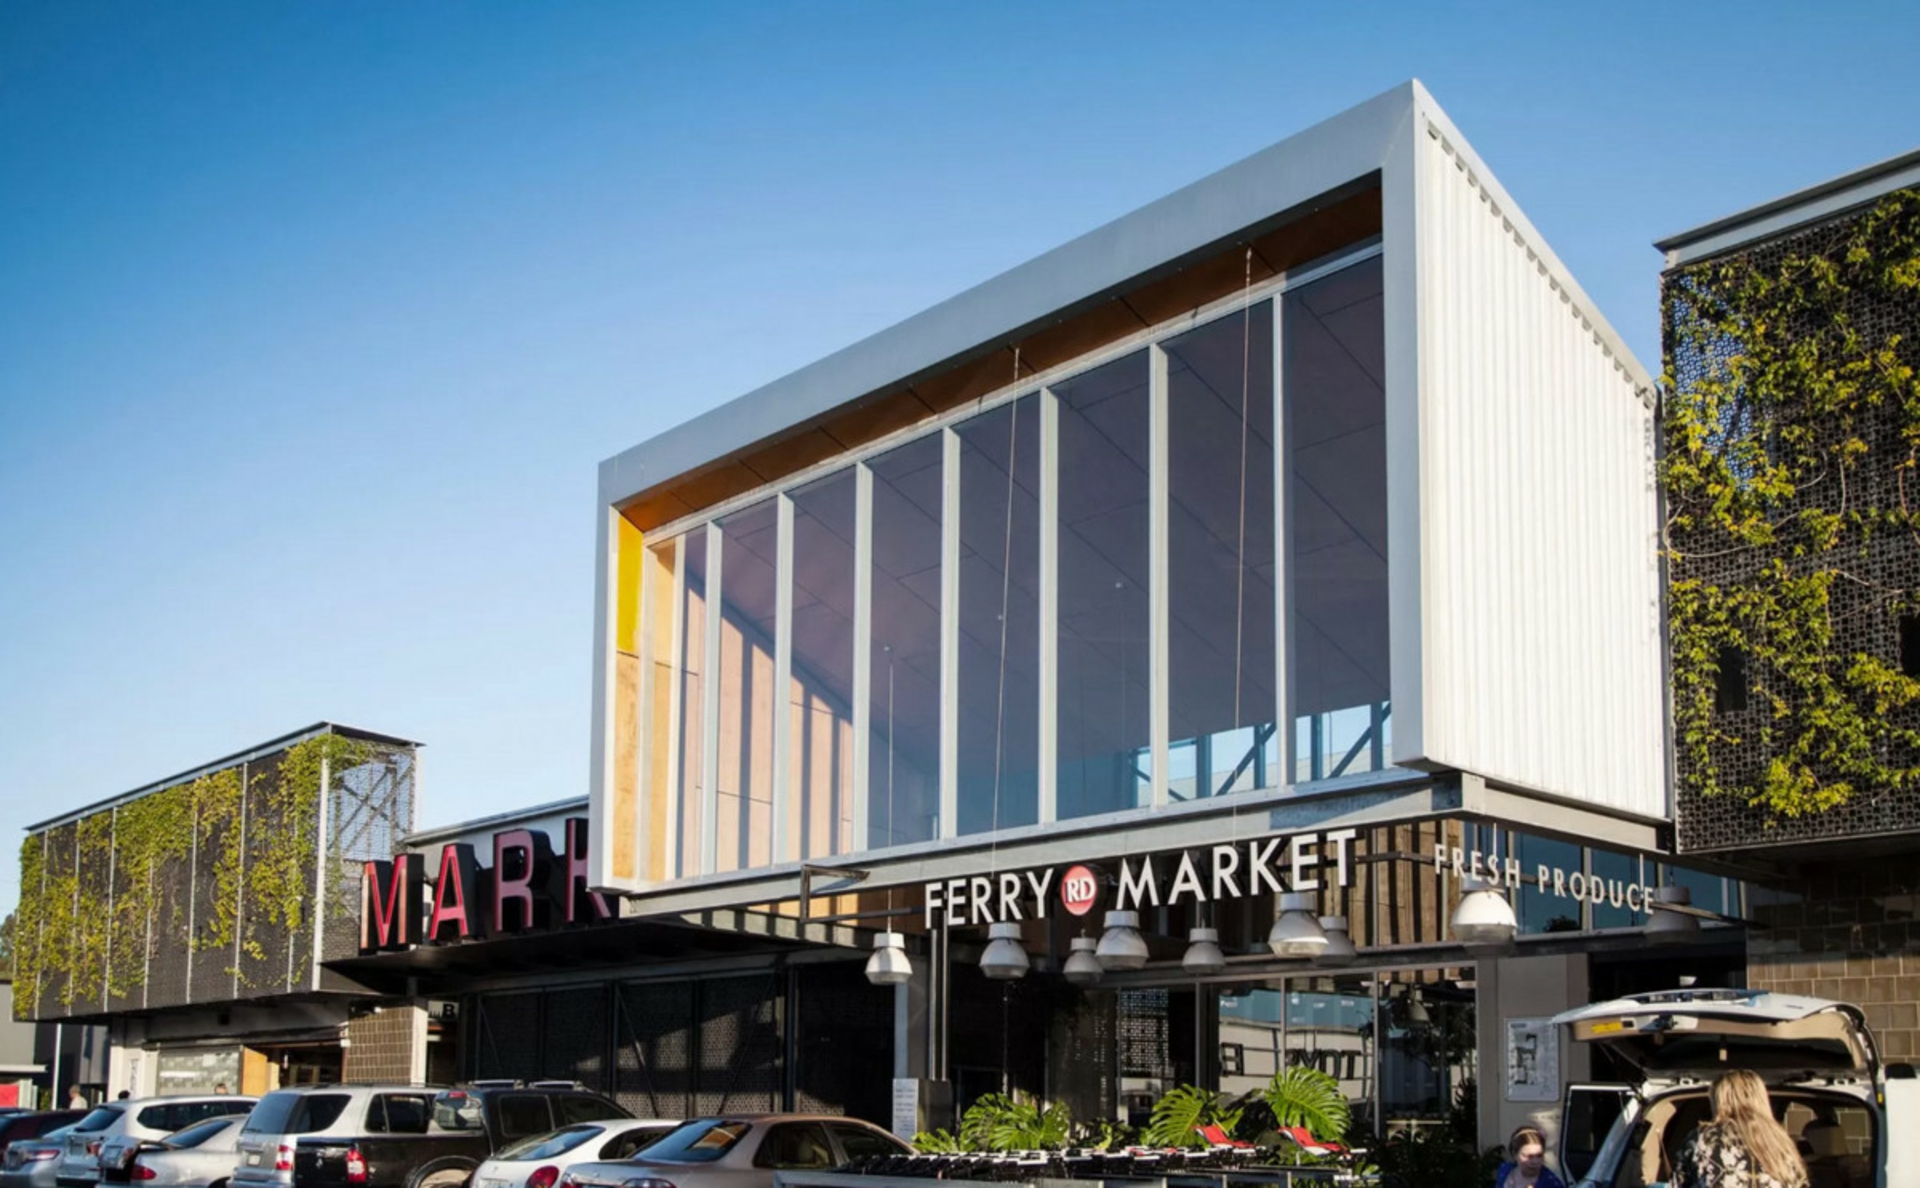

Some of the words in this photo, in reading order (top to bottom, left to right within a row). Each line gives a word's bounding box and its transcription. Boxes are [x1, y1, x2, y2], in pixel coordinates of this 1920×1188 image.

[925, 868, 1054, 929] FERRY
[1066, 877, 1096, 903] RD
[1116, 829, 1356, 910] MARKET
[1435, 844, 1521, 889] FRESH
[1538, 864, 1654, 914] PRODUCE
